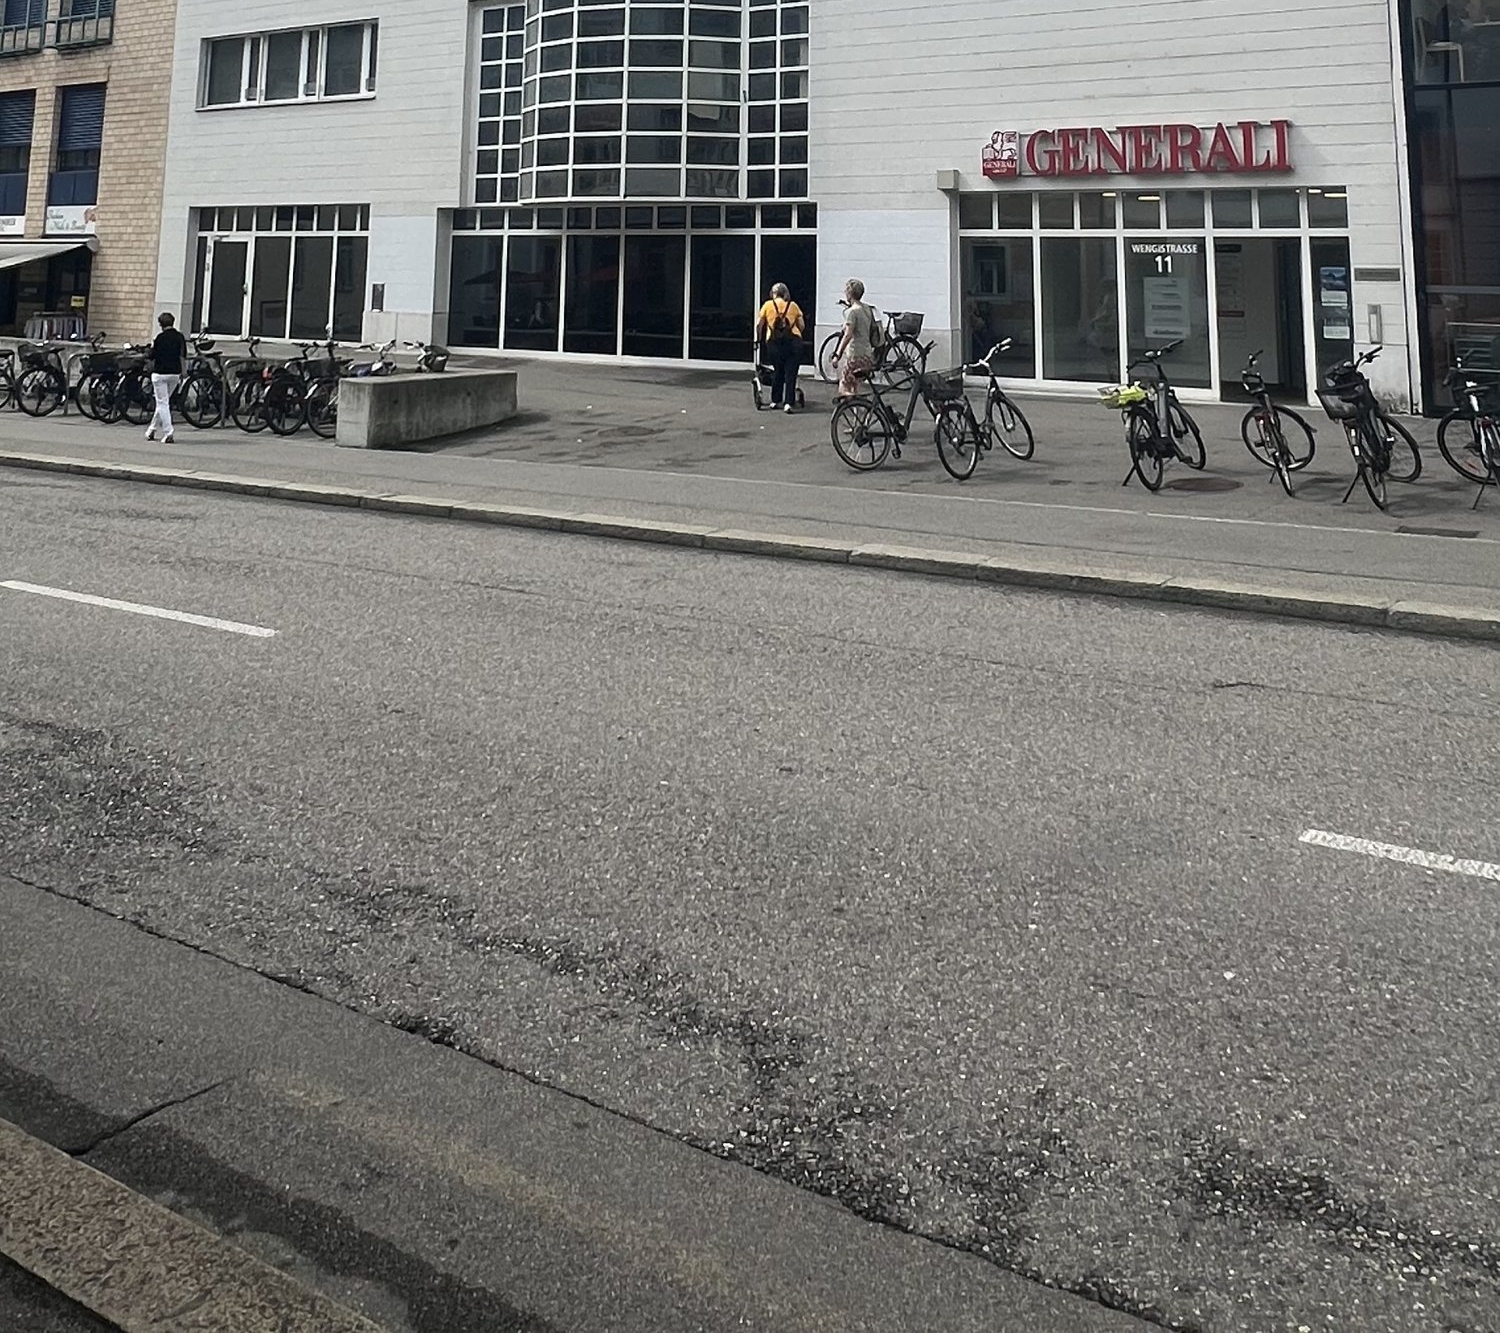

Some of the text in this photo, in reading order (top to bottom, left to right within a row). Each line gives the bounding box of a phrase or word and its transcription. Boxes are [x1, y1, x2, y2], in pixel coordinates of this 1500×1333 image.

[1025, 119, 1294, 176] GENERALI
[1131, 244, 1198, 254] WENGISTRASSE
[1154, 255, 1173, 273] 11
